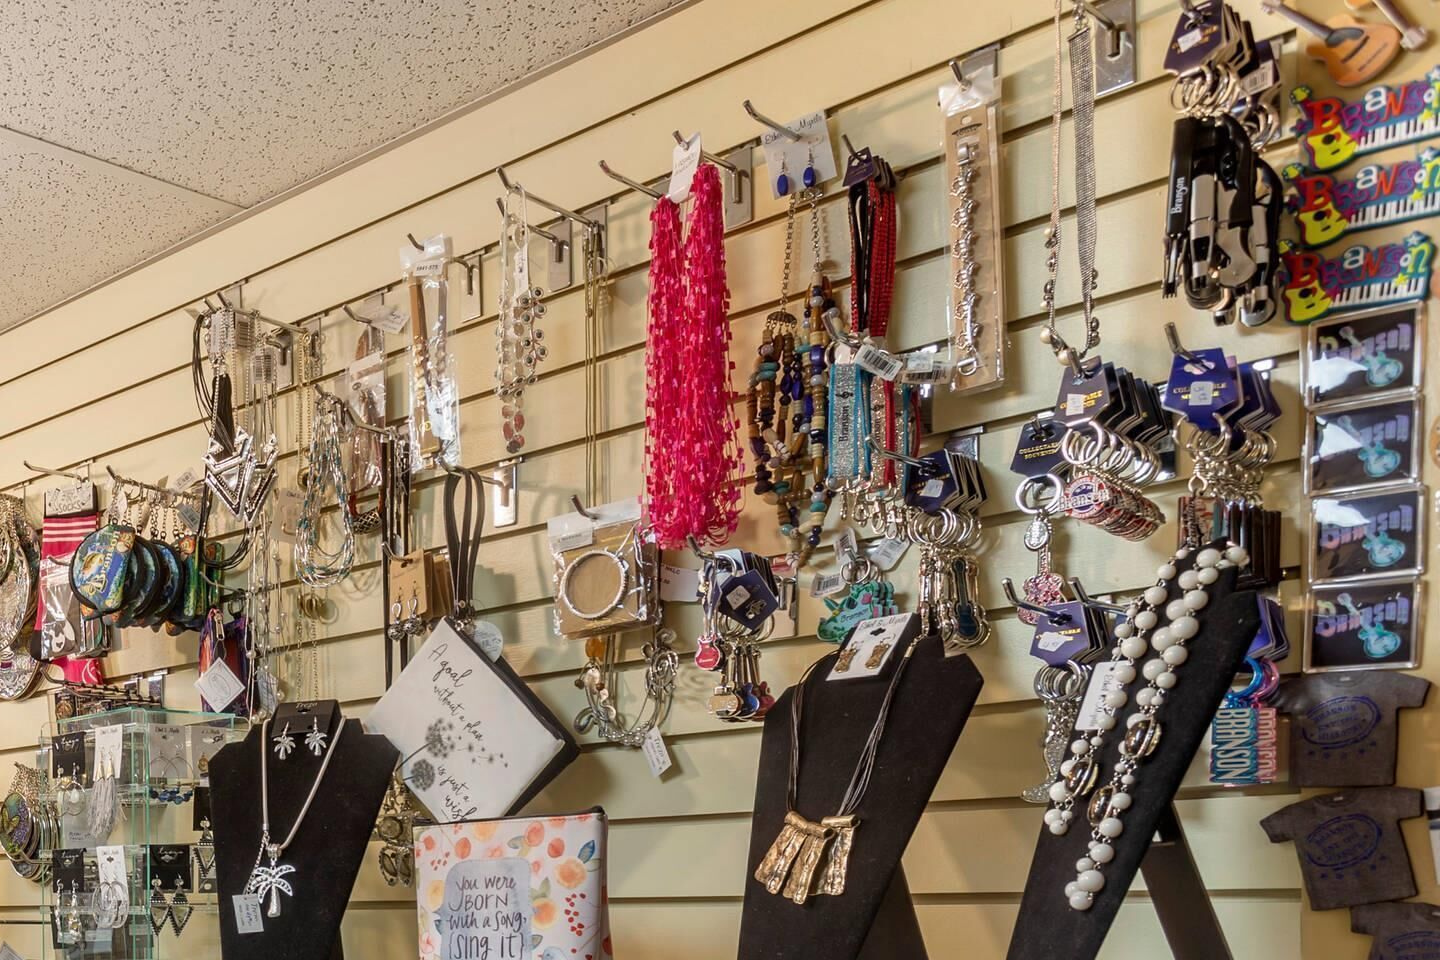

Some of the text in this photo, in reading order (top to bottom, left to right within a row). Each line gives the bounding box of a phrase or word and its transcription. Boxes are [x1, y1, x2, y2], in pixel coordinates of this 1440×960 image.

[1169, 176, 1186, 215] Branson
[838, 404, 850, 445] Branson
[432, 659, 473, 688] goal
[1232, 708, 1251, 780] BRANSON
[439, 776, 470, 797] just
[484, 875, 517, 890] were
[446, 911, 479, 931] with
